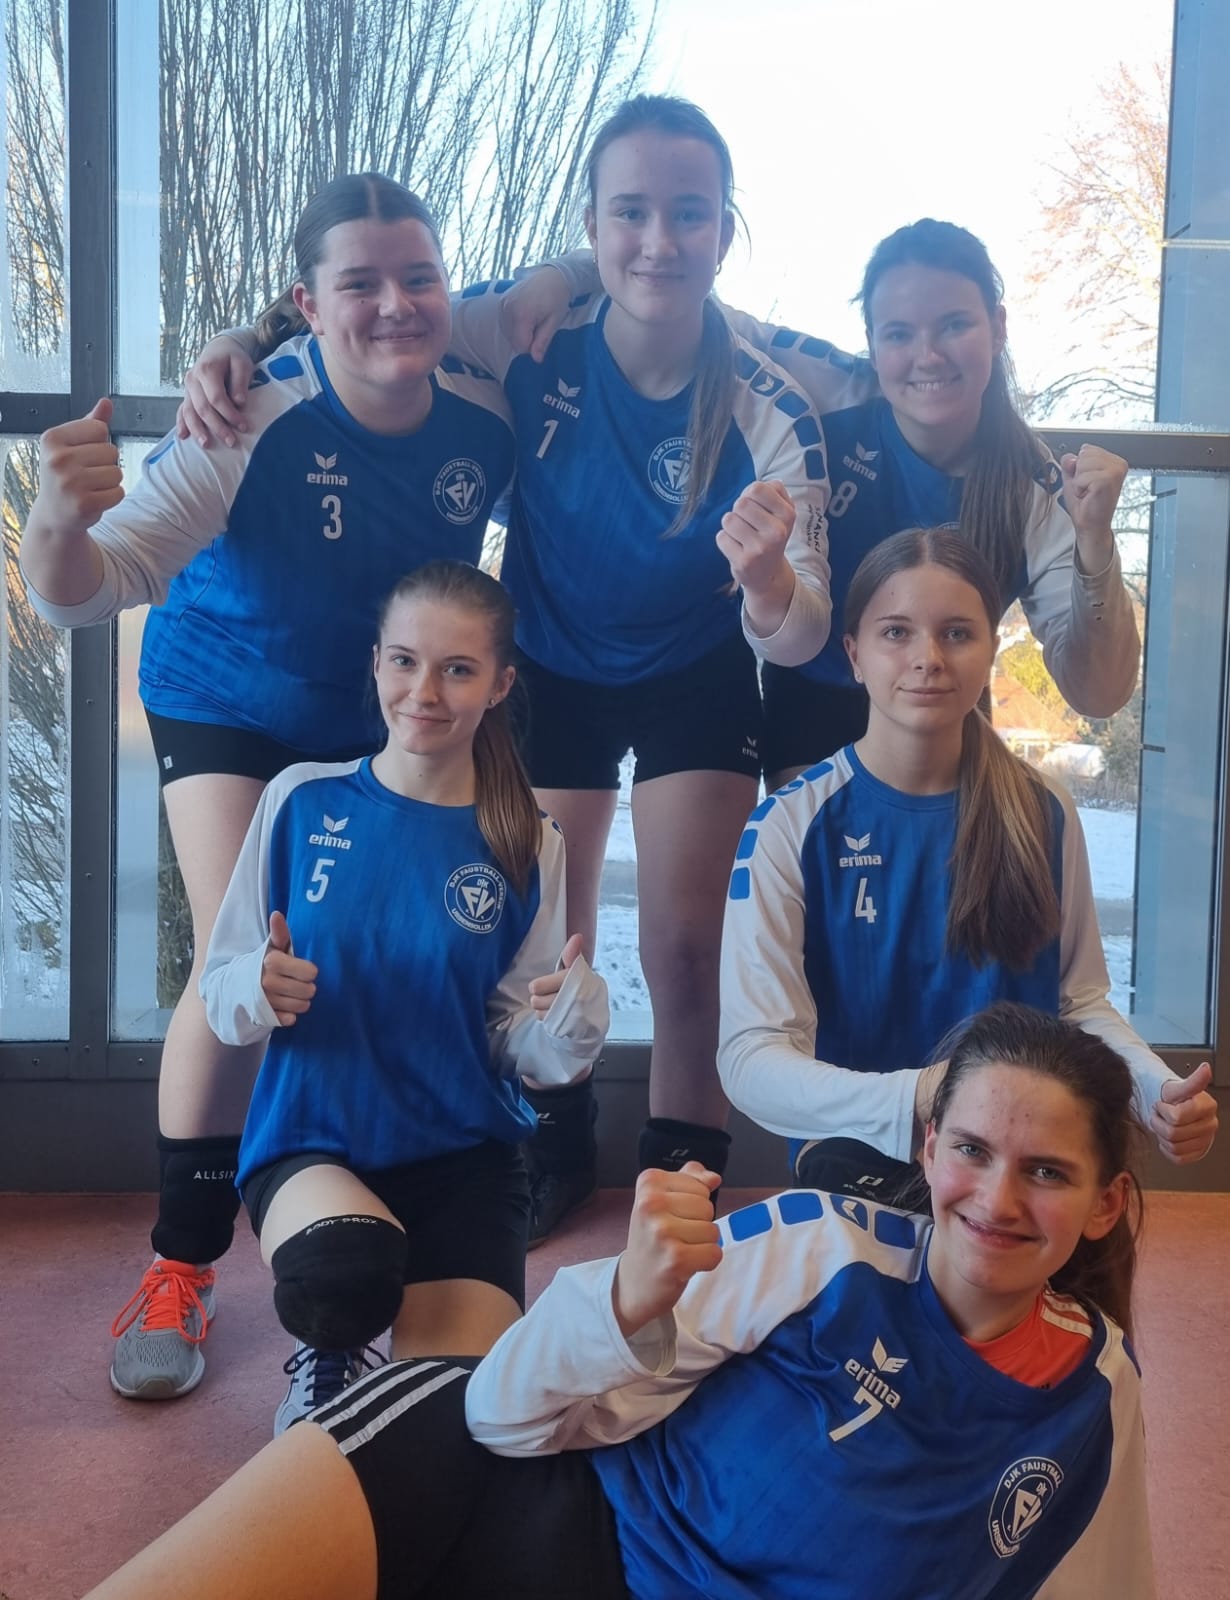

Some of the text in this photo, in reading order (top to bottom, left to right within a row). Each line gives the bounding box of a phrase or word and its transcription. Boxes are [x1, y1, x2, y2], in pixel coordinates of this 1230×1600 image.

[543, 394, 581, 419] erima
[536, 419, 559, 459] 1
[306, 471, 348, 486] erima
[843, 455, 878, 481] erima
[828, 480, 858, 517] 8
[321, 495, 342, 539] 3
[309, 833, 352, 850] erima
[839, 853, 882, 868] erima
[306, 858, 335, 903] 5
[449, 874, 461, 888] DJK
[855, 877, 877, 923] 4
[193, 1170, 236, 1180] ALLSIX
[844, 1358, 901, 1409] erima
[828, 1385, 884, 1442] 7
[1004, 1467, 1021, 1489] DJK
